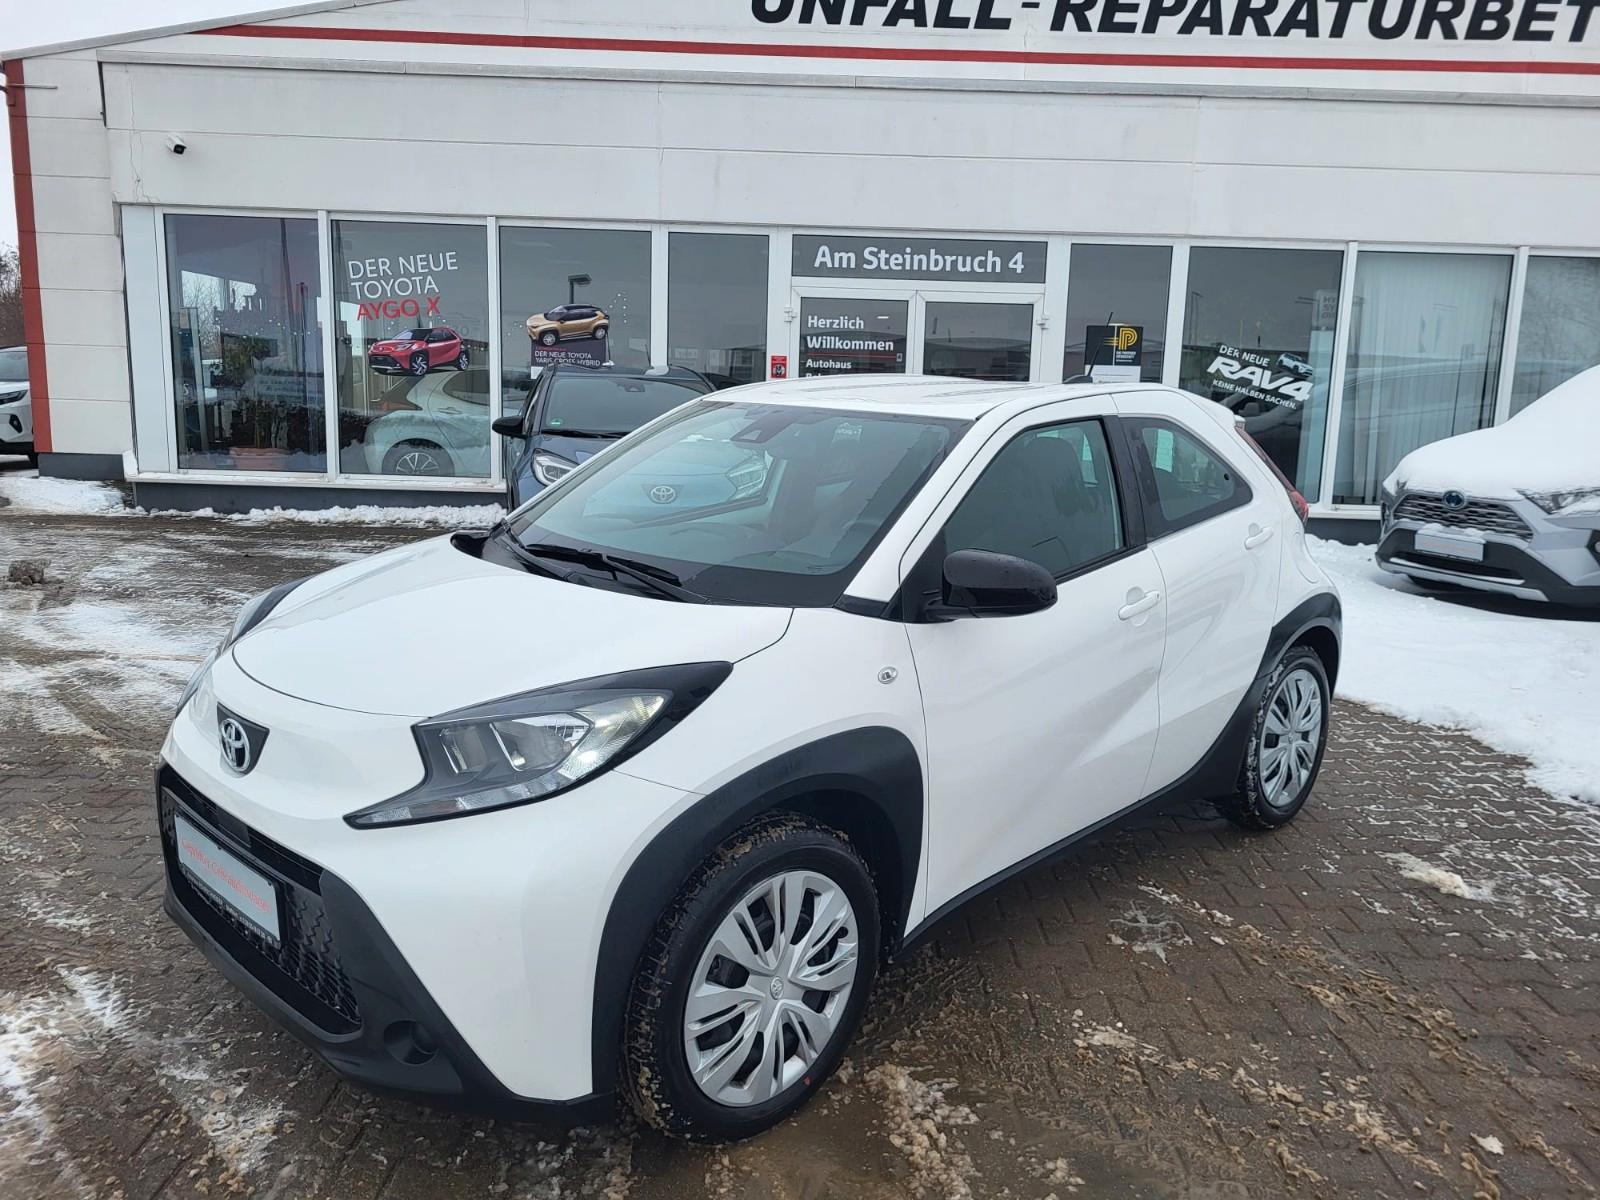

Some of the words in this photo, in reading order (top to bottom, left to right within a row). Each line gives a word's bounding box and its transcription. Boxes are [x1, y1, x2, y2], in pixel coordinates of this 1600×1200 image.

[348, 258, 392, 279] DER
[398, 251, 459, 274] NEUE
[814, 245, 856, 269] Am
[862, 246, 1002, 273] Steinbruch
[1008, 251, 1025, 274] 4
[350, 275, 440, 300] TOYOTA
[356, 298, 420, 321] AYGO
[426, 296, 441, 316] X
[807, 315, 865, 329] Herzlich
[806, 335, 894, 351] Willkommen
[1219, 344, 1240, 358] DER
[1241, 351, 1271, 367] NEUE
[806, 359, 852, 369] Autohaus
[1206, 356, 1314, 402] RAV4
[1212, 379, 1236, 391] KEINE
[1235, 386, 1265, 400] HALBEN
[1265, 394, 1297, 410] SACHEN.
